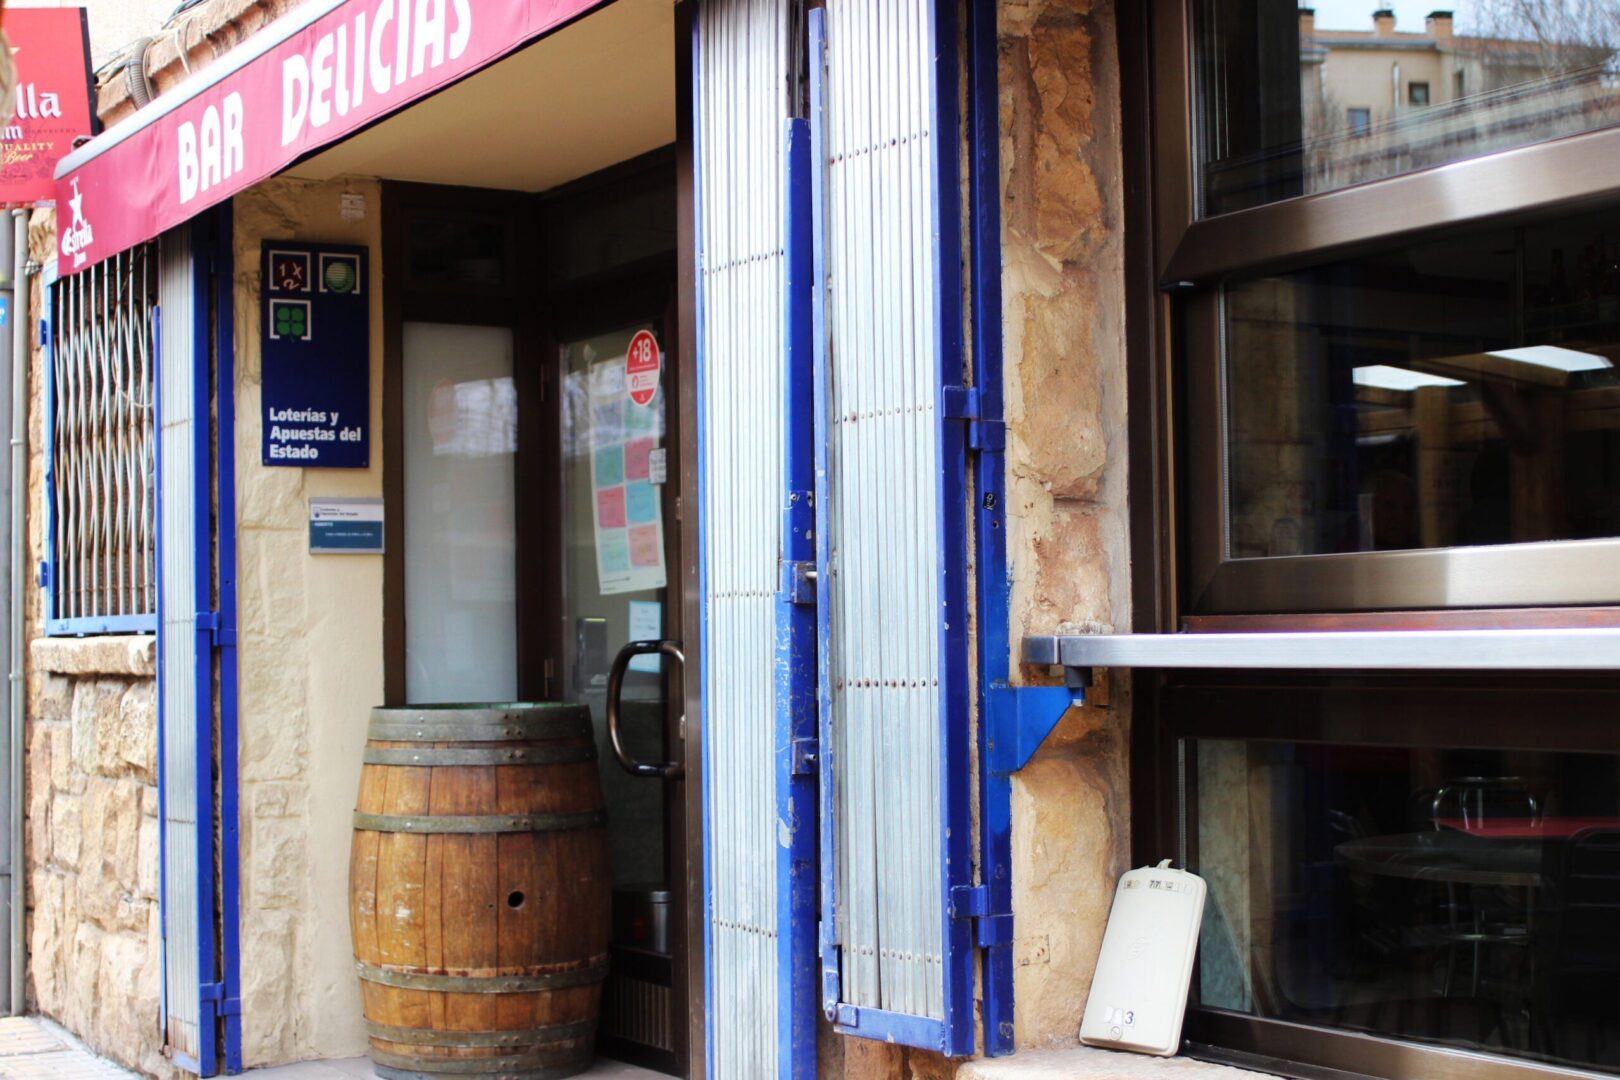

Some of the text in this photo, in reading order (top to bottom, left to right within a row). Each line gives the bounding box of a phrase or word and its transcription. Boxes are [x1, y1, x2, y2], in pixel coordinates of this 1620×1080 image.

[16, 82, 62, 119] lla
[177, 0, 472, 205] BAR DELICIAS
[269, 407, 339, 426] Loterías y
[270, 425, 362, 444] Apuestas del
[269, 443, 319, 460] Estado
